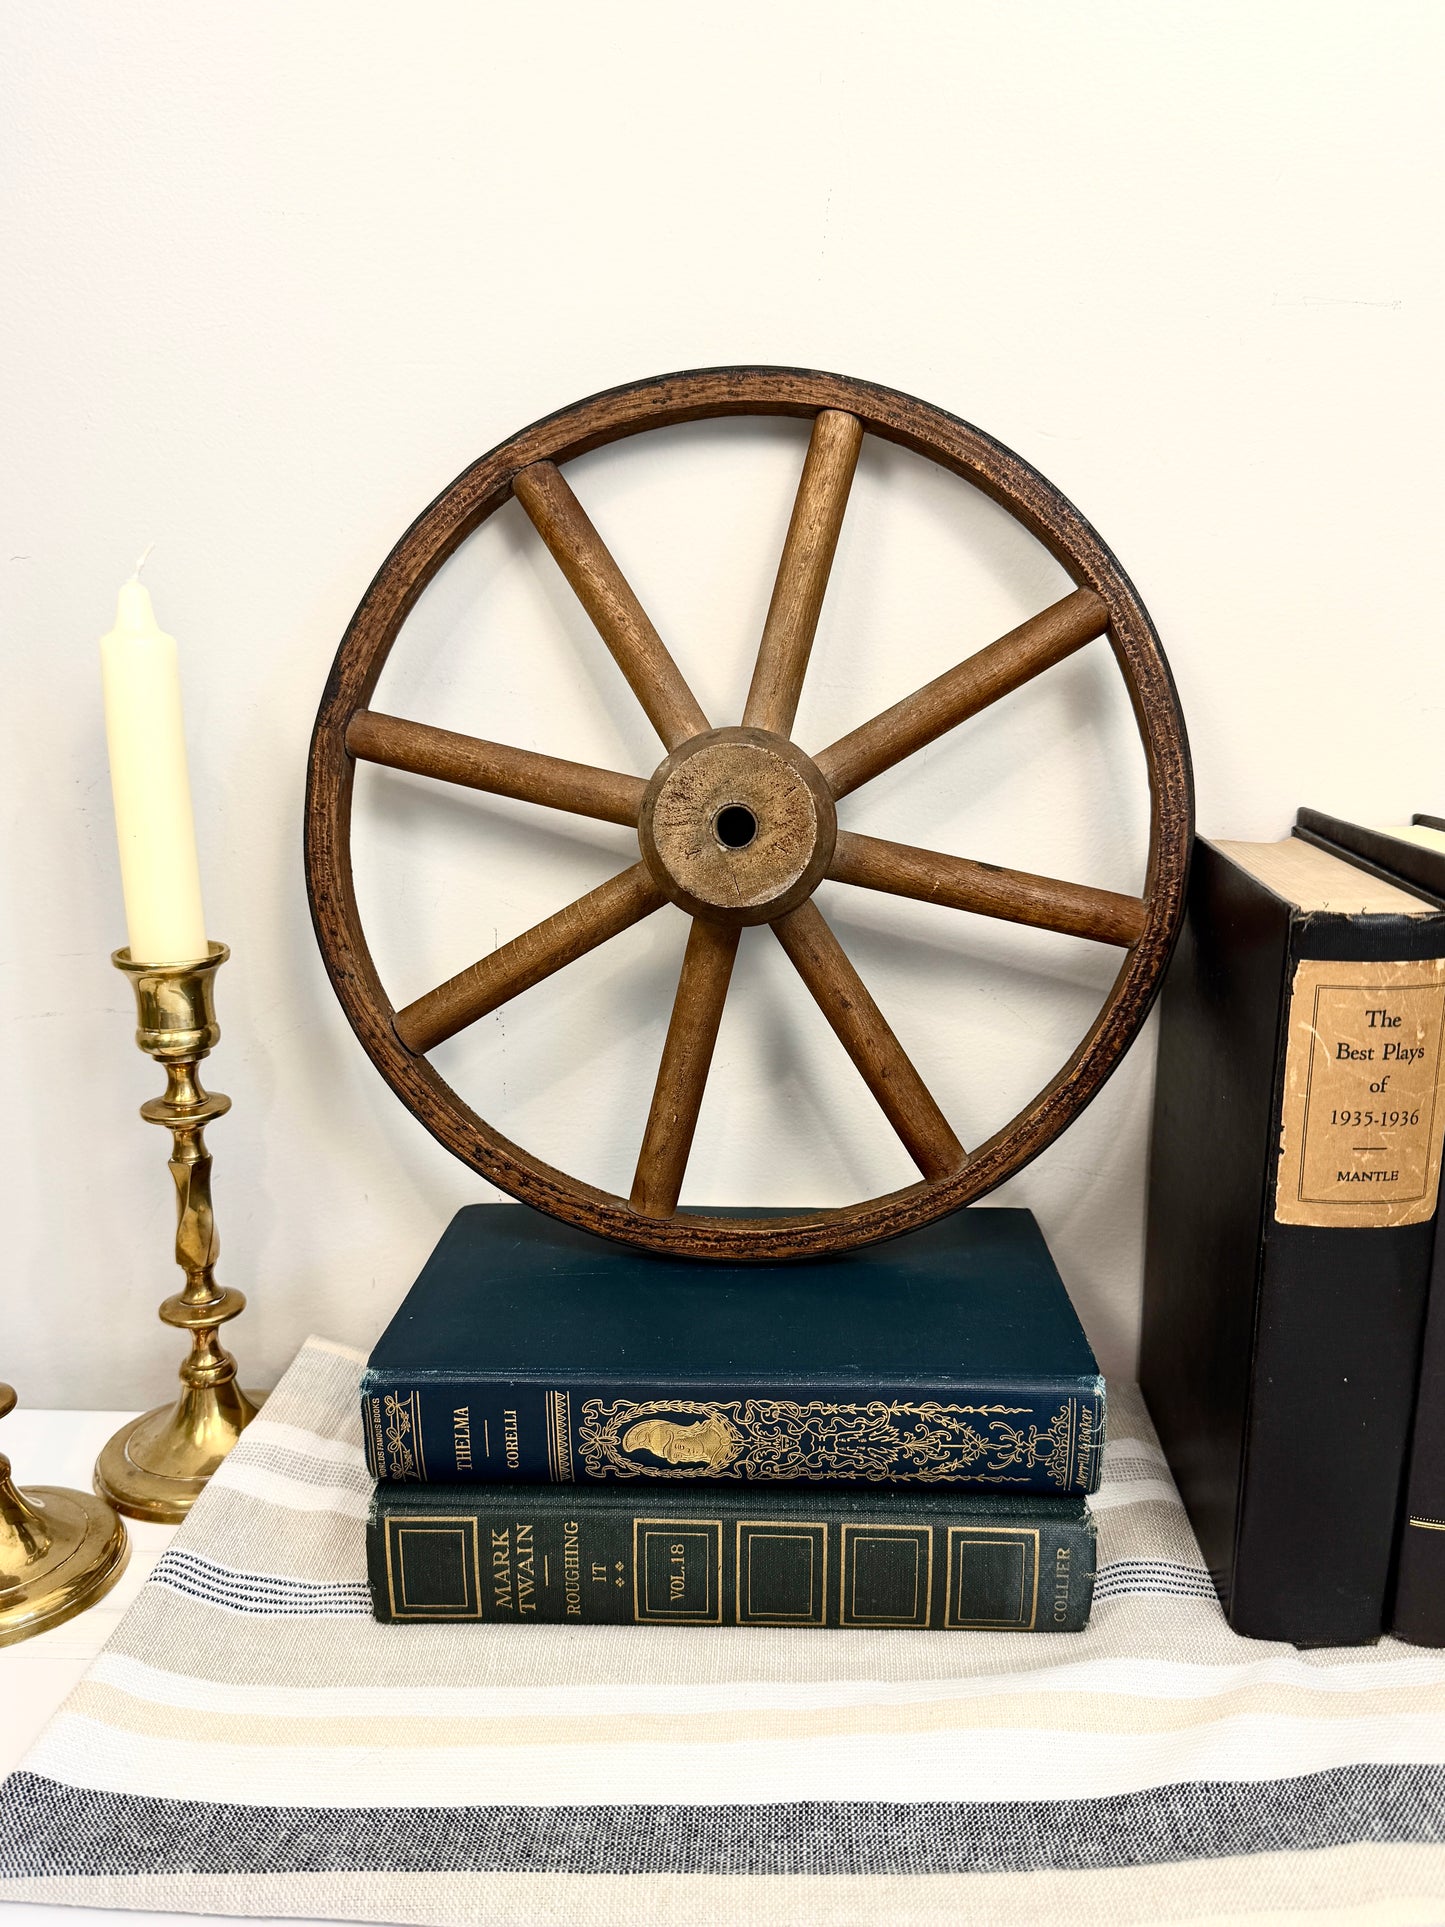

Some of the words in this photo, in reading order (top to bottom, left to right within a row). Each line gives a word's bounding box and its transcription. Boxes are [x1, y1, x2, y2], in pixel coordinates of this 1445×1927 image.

[1365, 1009, 1402, 1028] The
[1335, 1042, 1375, 1060] Best
[1382, 1042, 1425, 1065] Plays
[1369, 1075, 1390, 1093] of
[1330, 1108, 1420, 1127] 1935-1936
[1336, 1170, 1399, 1182] MANTLE
[371, 1397, 382, 1423] BOOKS
[374, 1424, 385, 1449] FAMOUS
[1078, 1404, 1093, 1443] Baker
[453, 1405, 474, 1471] THELMA
[503, 1409, 521, 1469] CORELLI
[1078, 1440, 1091, 1453] &
[1074, 1452, 1090, 1488] Merrill
[491, 1527, 514, 1609] MARK
[516, 1522, 537, 1614] TWAIN
[564, 1520, 582, 1615] ROUGHING
[592, 1562, 607, 1583] IT
[1053, 1547, 1071, 1623] COLLIER
